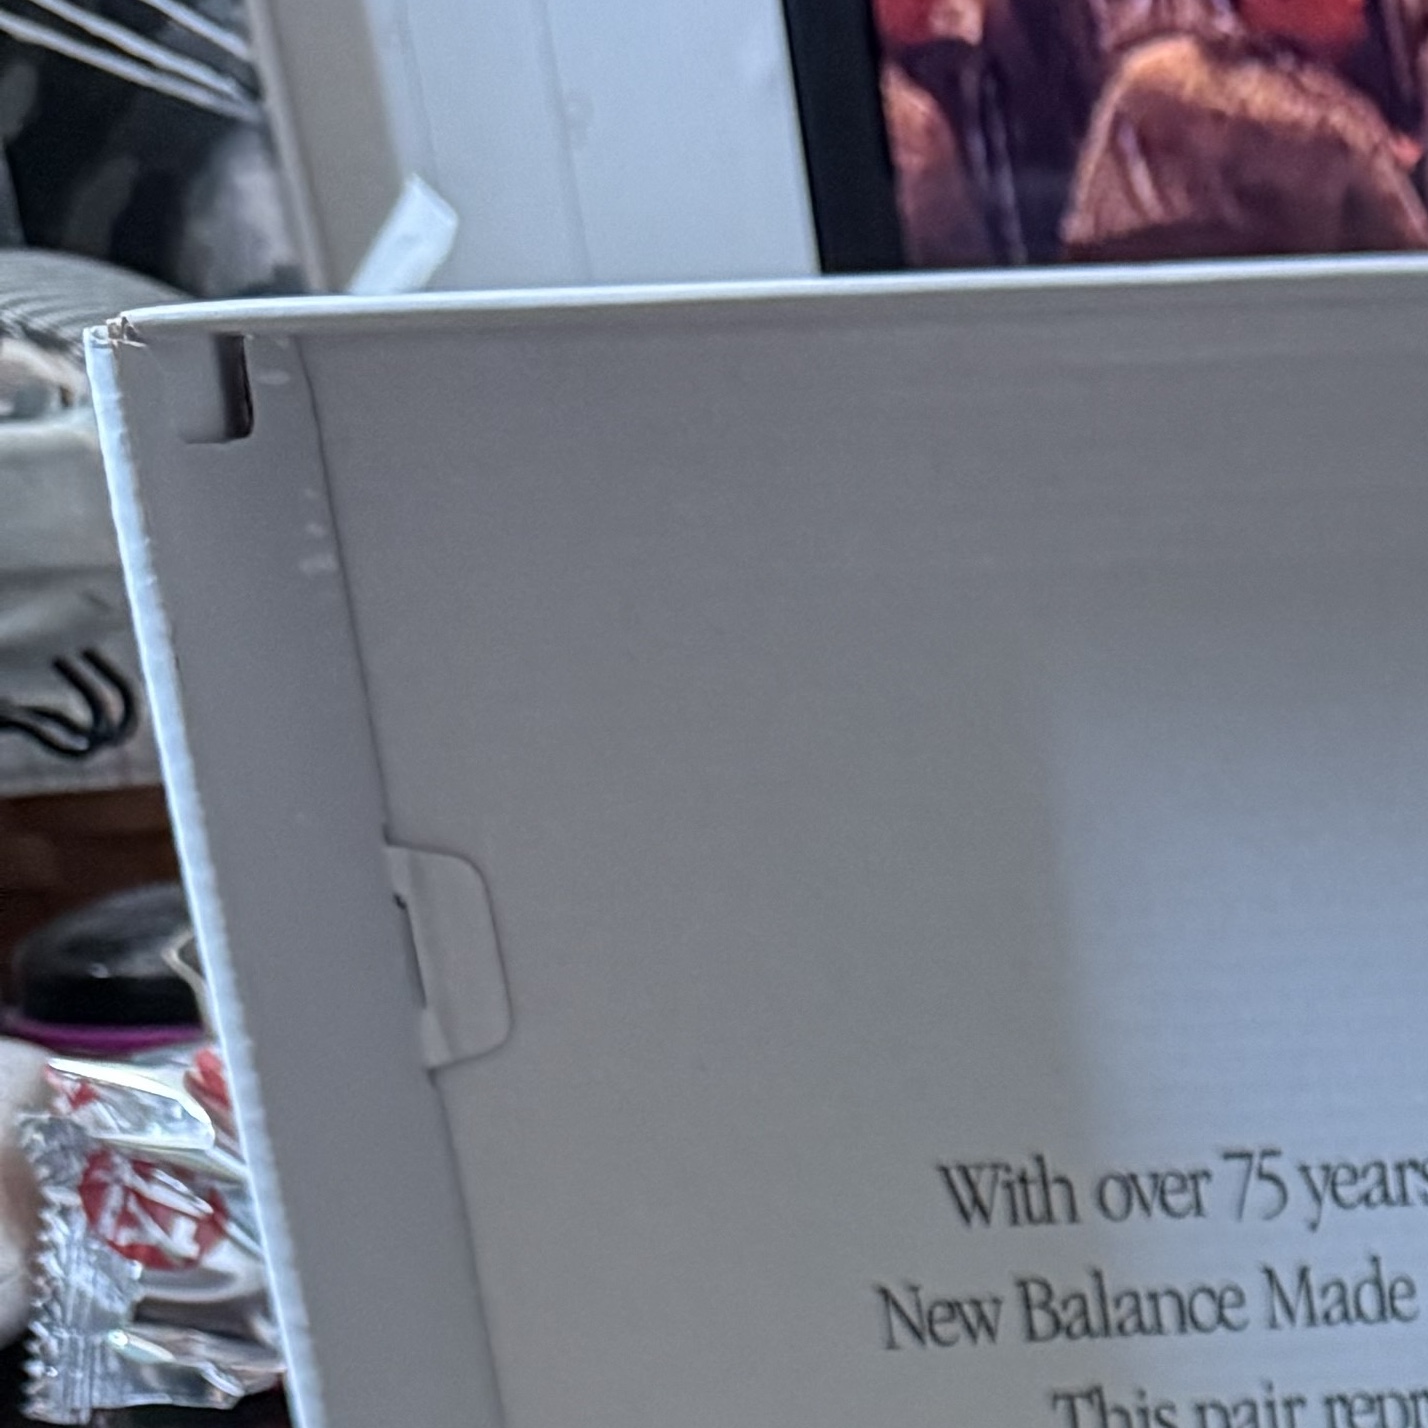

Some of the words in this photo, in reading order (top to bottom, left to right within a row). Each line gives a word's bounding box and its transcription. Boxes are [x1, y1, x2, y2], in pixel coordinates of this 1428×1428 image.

[936, 1152, 1081, 1227] With
[1097, 1167, 1213, 1223] over
[1222, 1149, 1290, 1222] 75
[875, 1284, 1001, 1351] New
[1015, 1264, 1251, 1344] Balance
[1259, 1254, 1418, 1331] Made
